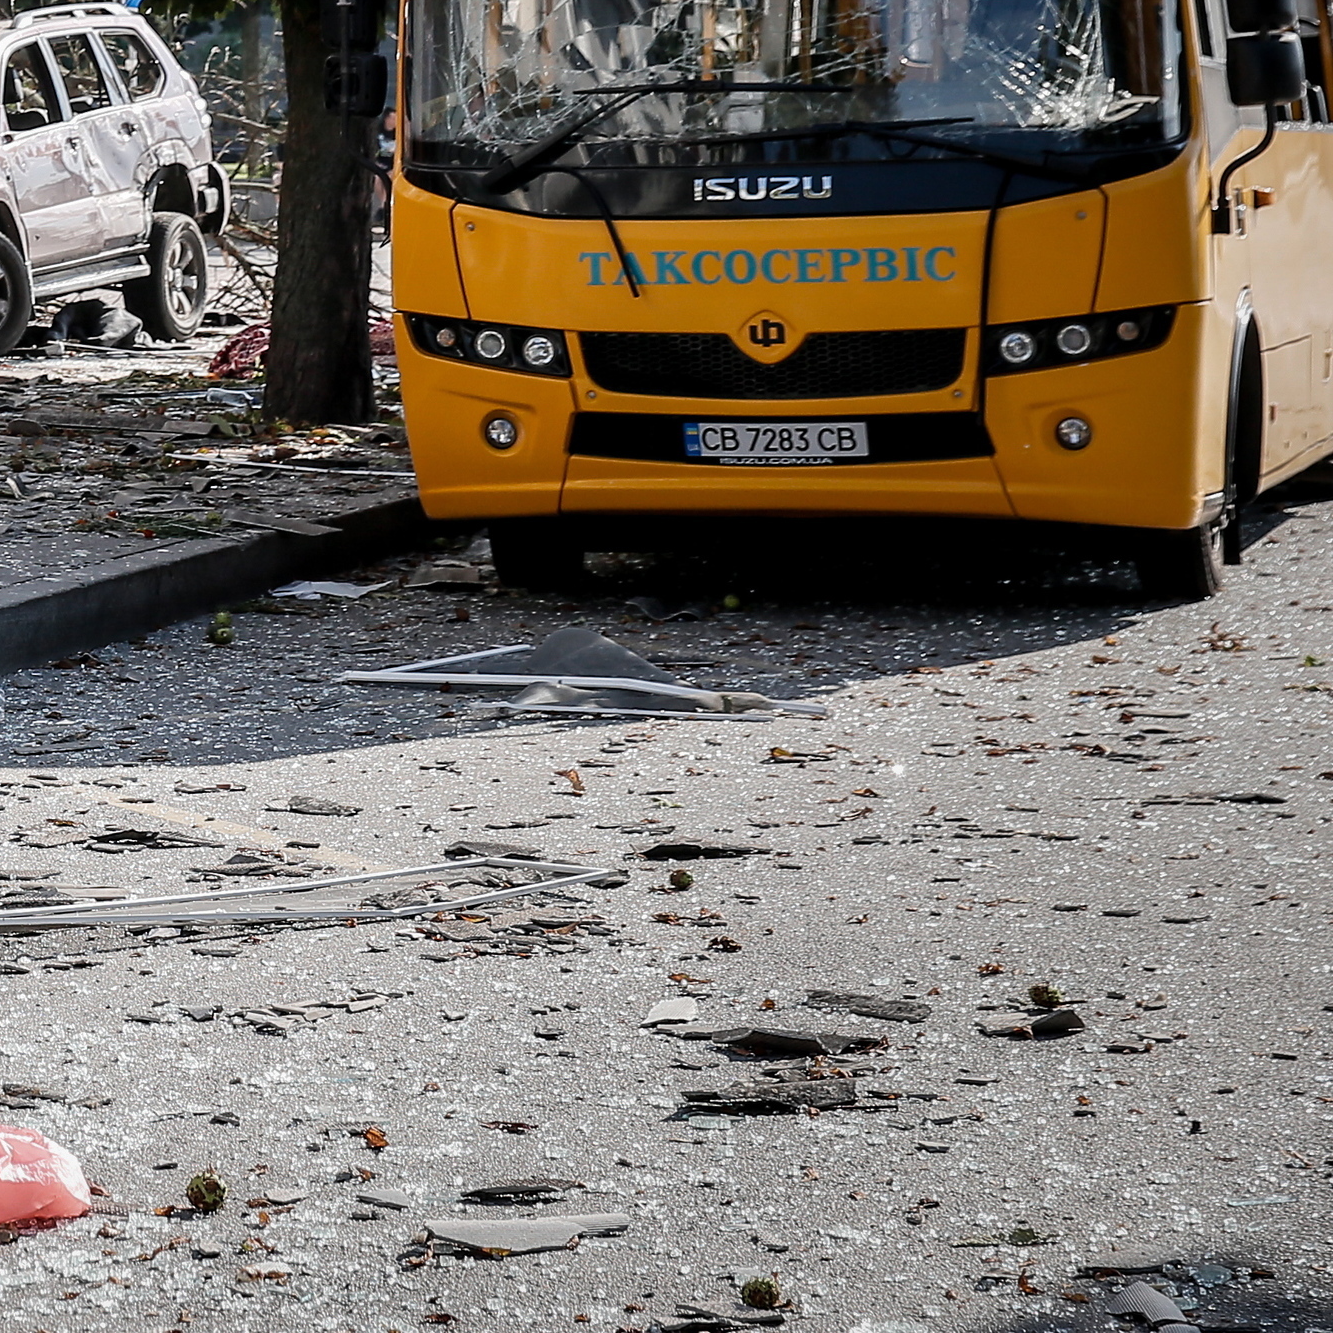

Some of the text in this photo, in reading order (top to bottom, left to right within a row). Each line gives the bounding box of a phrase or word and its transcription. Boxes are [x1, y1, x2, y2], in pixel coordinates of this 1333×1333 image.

[693, 175, 833, 201] ISUZU
[578, 245, 957, 286] ТАКСОСЕРВІС
[701, 427, 857, 452] CB 7283 CB
[719, 457, 833, 465] ISUZU.COM.UA
